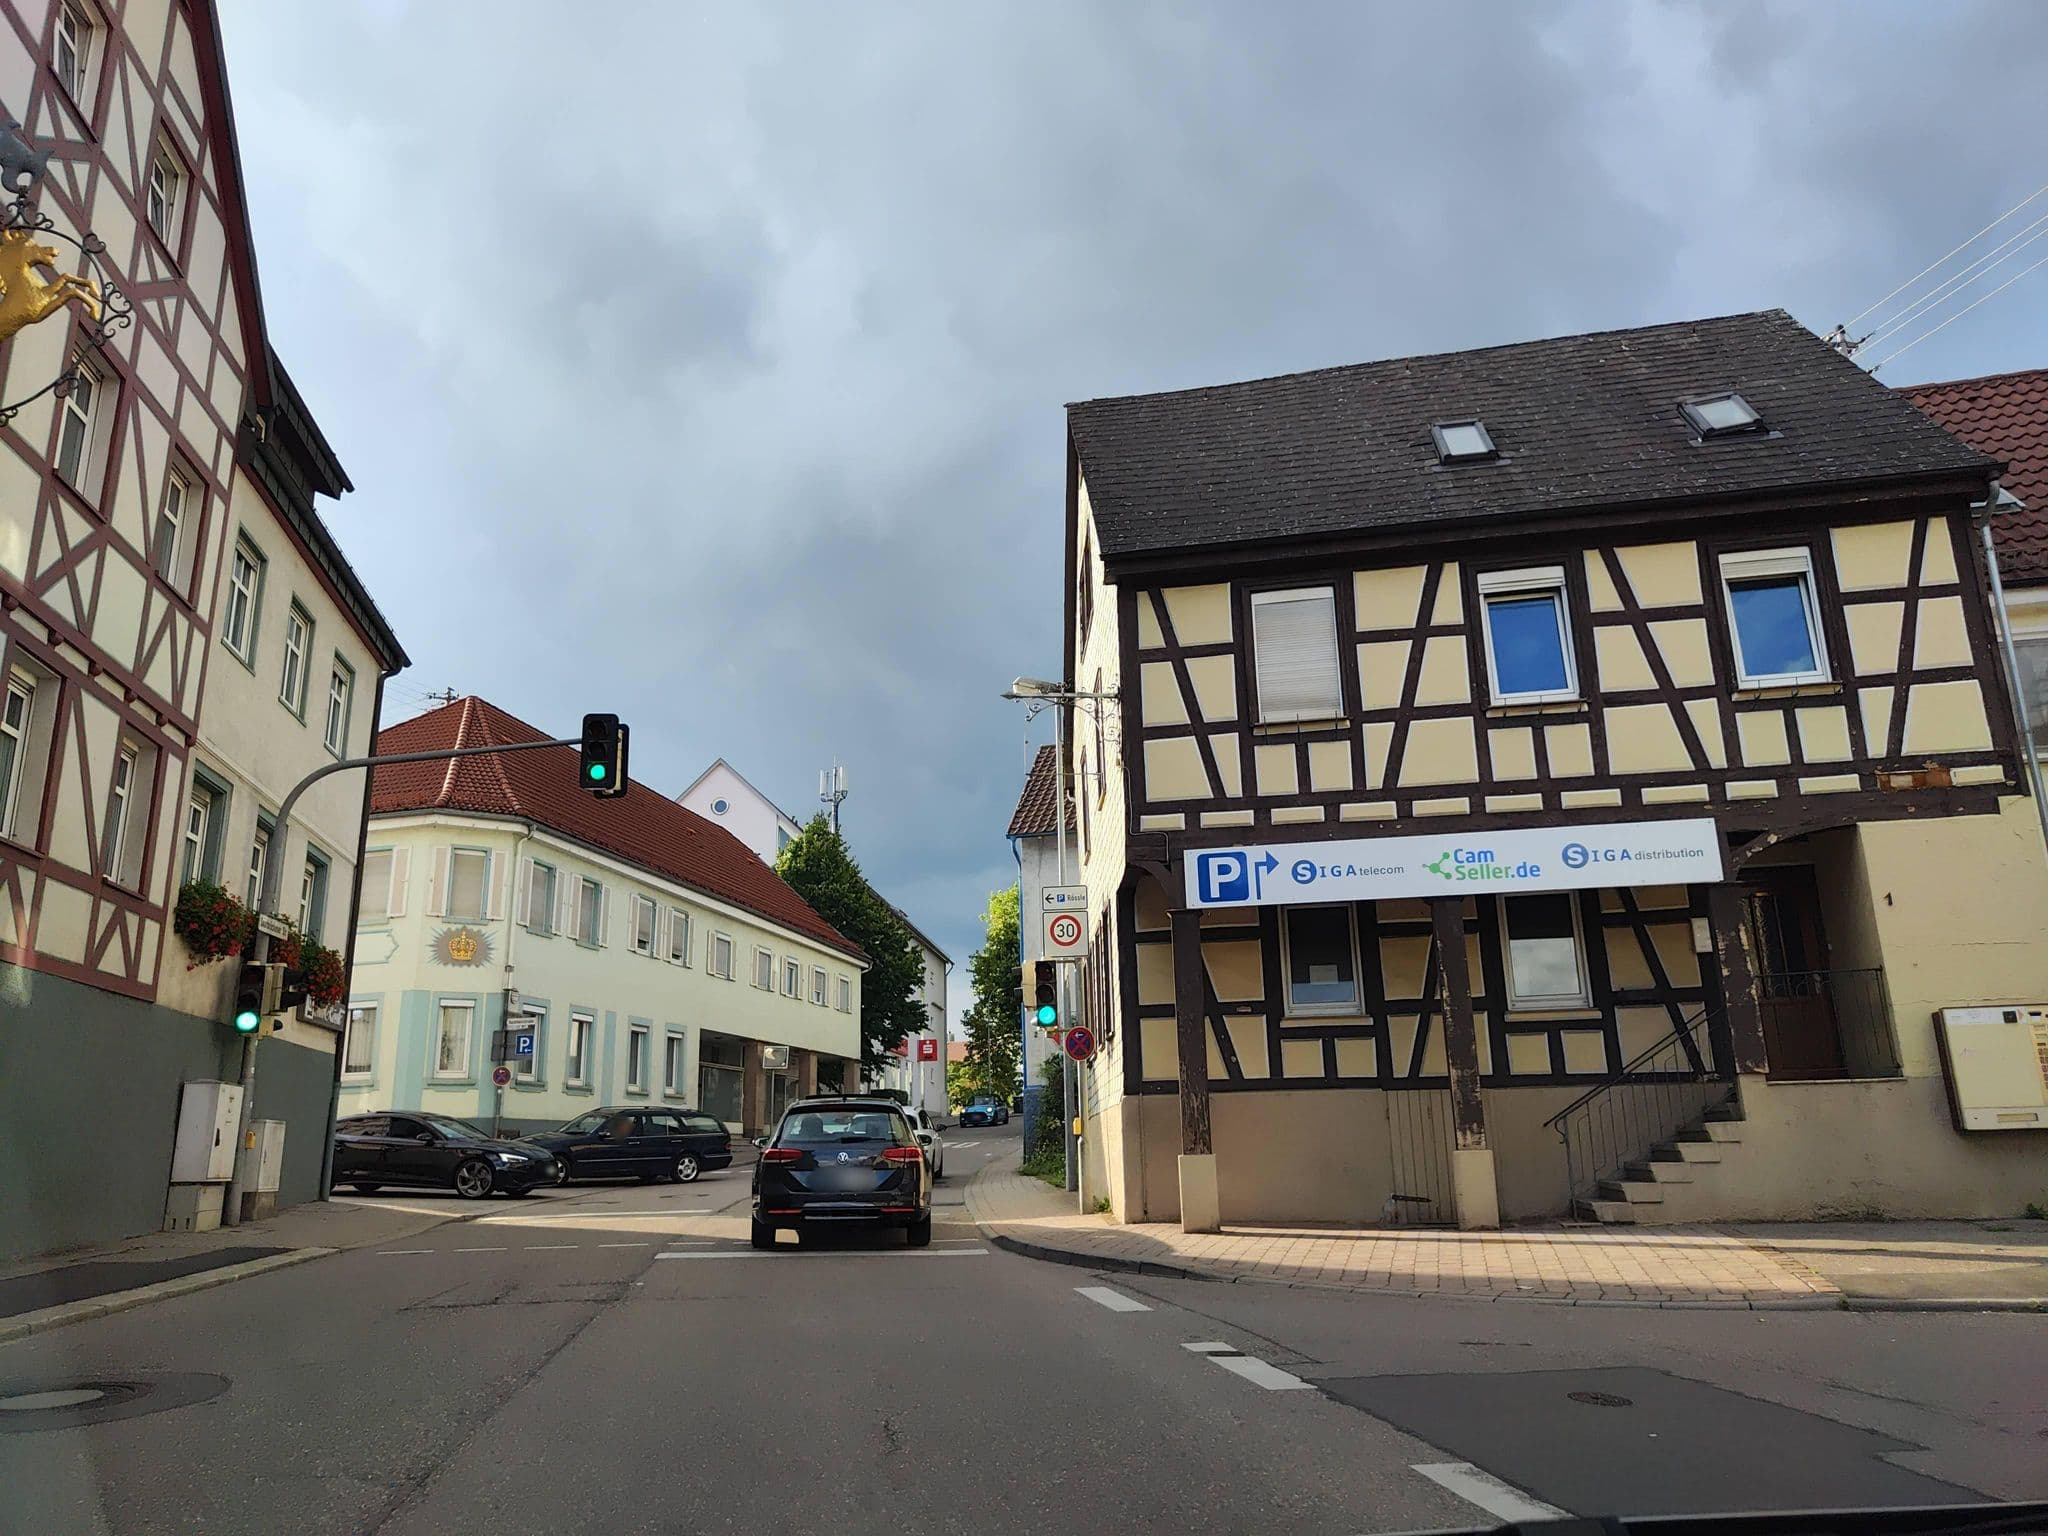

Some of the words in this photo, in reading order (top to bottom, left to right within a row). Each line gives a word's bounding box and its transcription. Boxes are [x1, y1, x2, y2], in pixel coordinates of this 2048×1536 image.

[1453, 848, 1495, 864] Cam
[1562, 843, 1632, 869] SIGA
[1634, 847, 1704, 862] distribution
[1208, 857, 1241, 898] P
[1291, 860, 1357, 885] SIGA
[1359, 864, 1404, 876] telecom
[1454, 861, 1541, 881] Seller.de
[1056, 923, 1075, 938] 30
[520, 1037, 530, 1052] P
